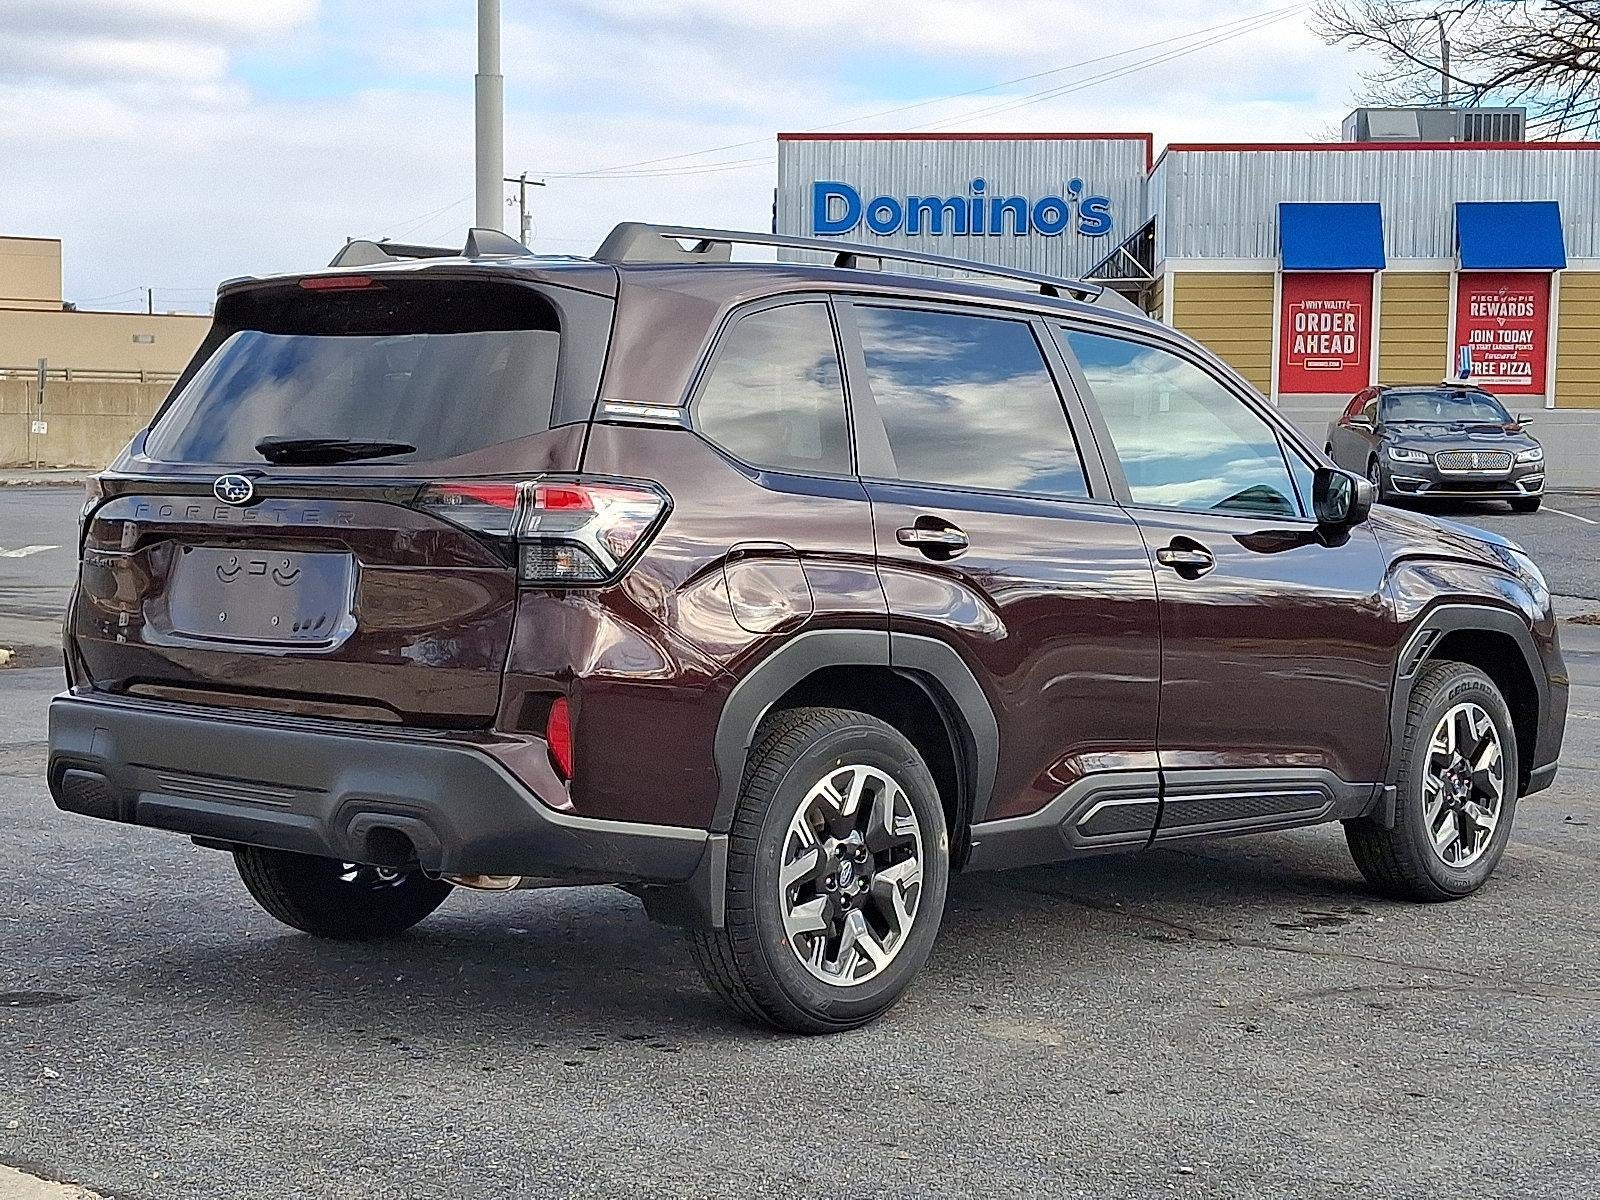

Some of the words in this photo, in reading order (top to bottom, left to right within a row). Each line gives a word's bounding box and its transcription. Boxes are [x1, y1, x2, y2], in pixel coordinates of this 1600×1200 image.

[813, 177, 1113, 236] Domino's
[1305, 300, 1323, 310] WHY
[1323, 300, 1347, 310] WAIT?
[1470, 303, 1534, 316] REWARDS
[1295, 313, 1355, 332] ORDER
[1469, 330, 1494, 343] JOIN
[1498, 330, 1534, 343] TODAY
[1293, 334, 1355, 354] AHEAD
[1484, 351, 1518, 360] toward
[1499, 361, 1532, 375] PIZZA
[134, 503, 357, 525] FORESTER
